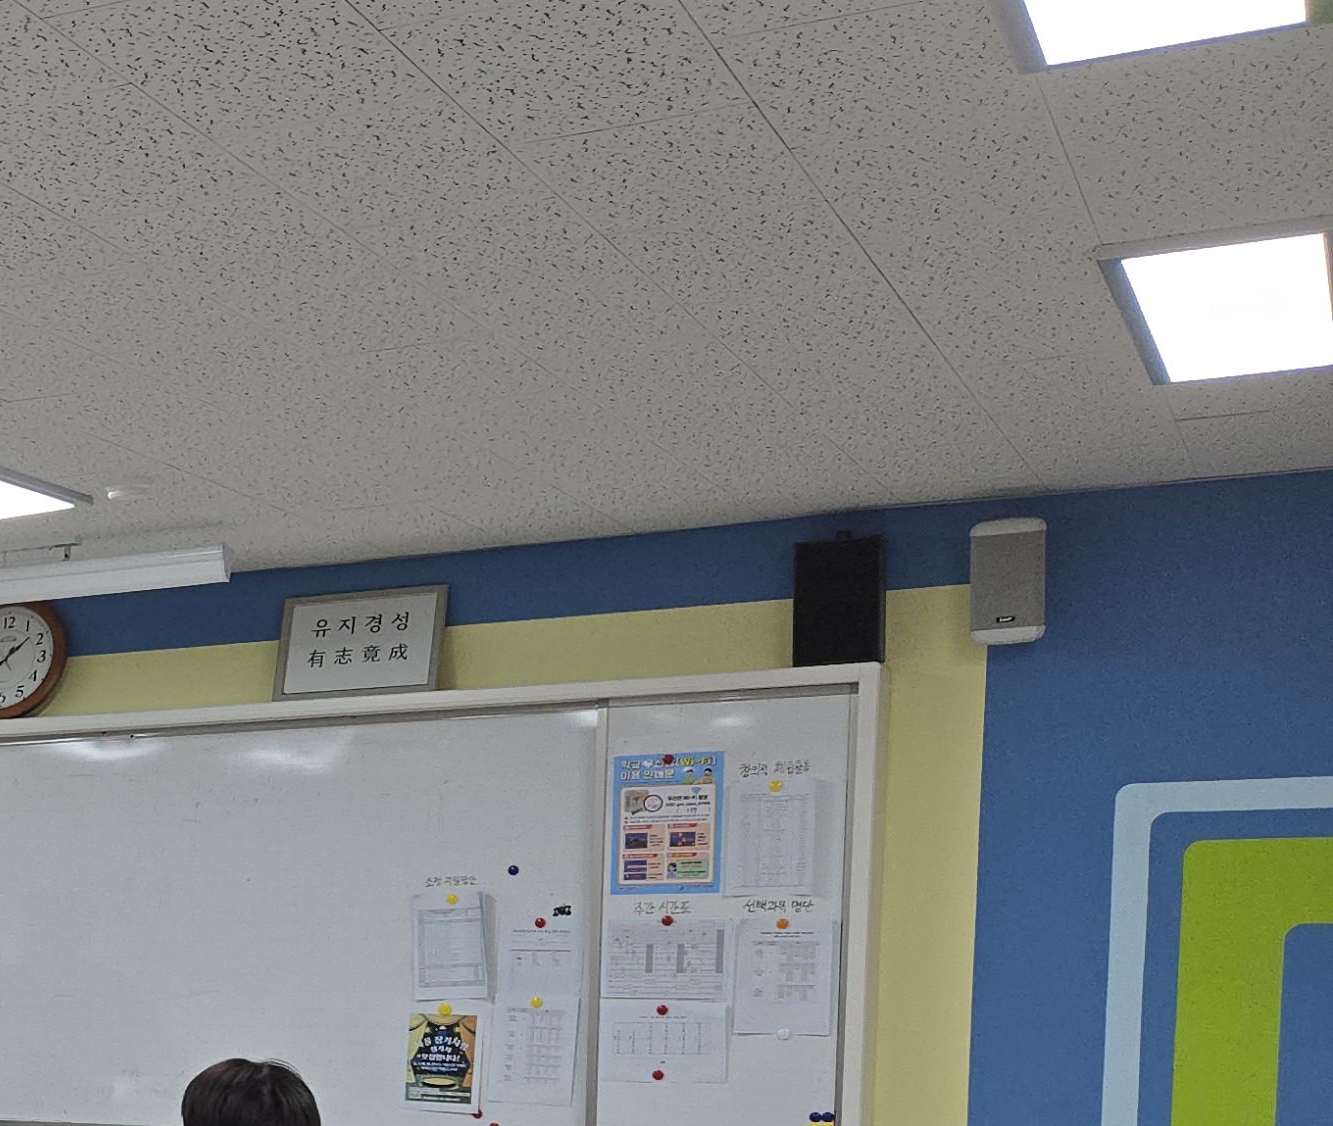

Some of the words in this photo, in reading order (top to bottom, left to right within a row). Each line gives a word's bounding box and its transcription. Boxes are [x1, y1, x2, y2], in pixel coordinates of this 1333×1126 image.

[3, 616, 16, 629] 12
[26, 620, 30, 632] 1
[311, 611, 410, 638] 유지경성
[36, 633, 44, 645] 2
[36, 650, 46, 663] 3
[28, 669, 38, 681] 4
[15, 685, 25, 698] 5
[633, 900, 655, 916] 주간
[658, 899, 692, 915] 시간표
[742, 899, 787, 914] 선택과목
[791, 900, 815, 913] 명단
